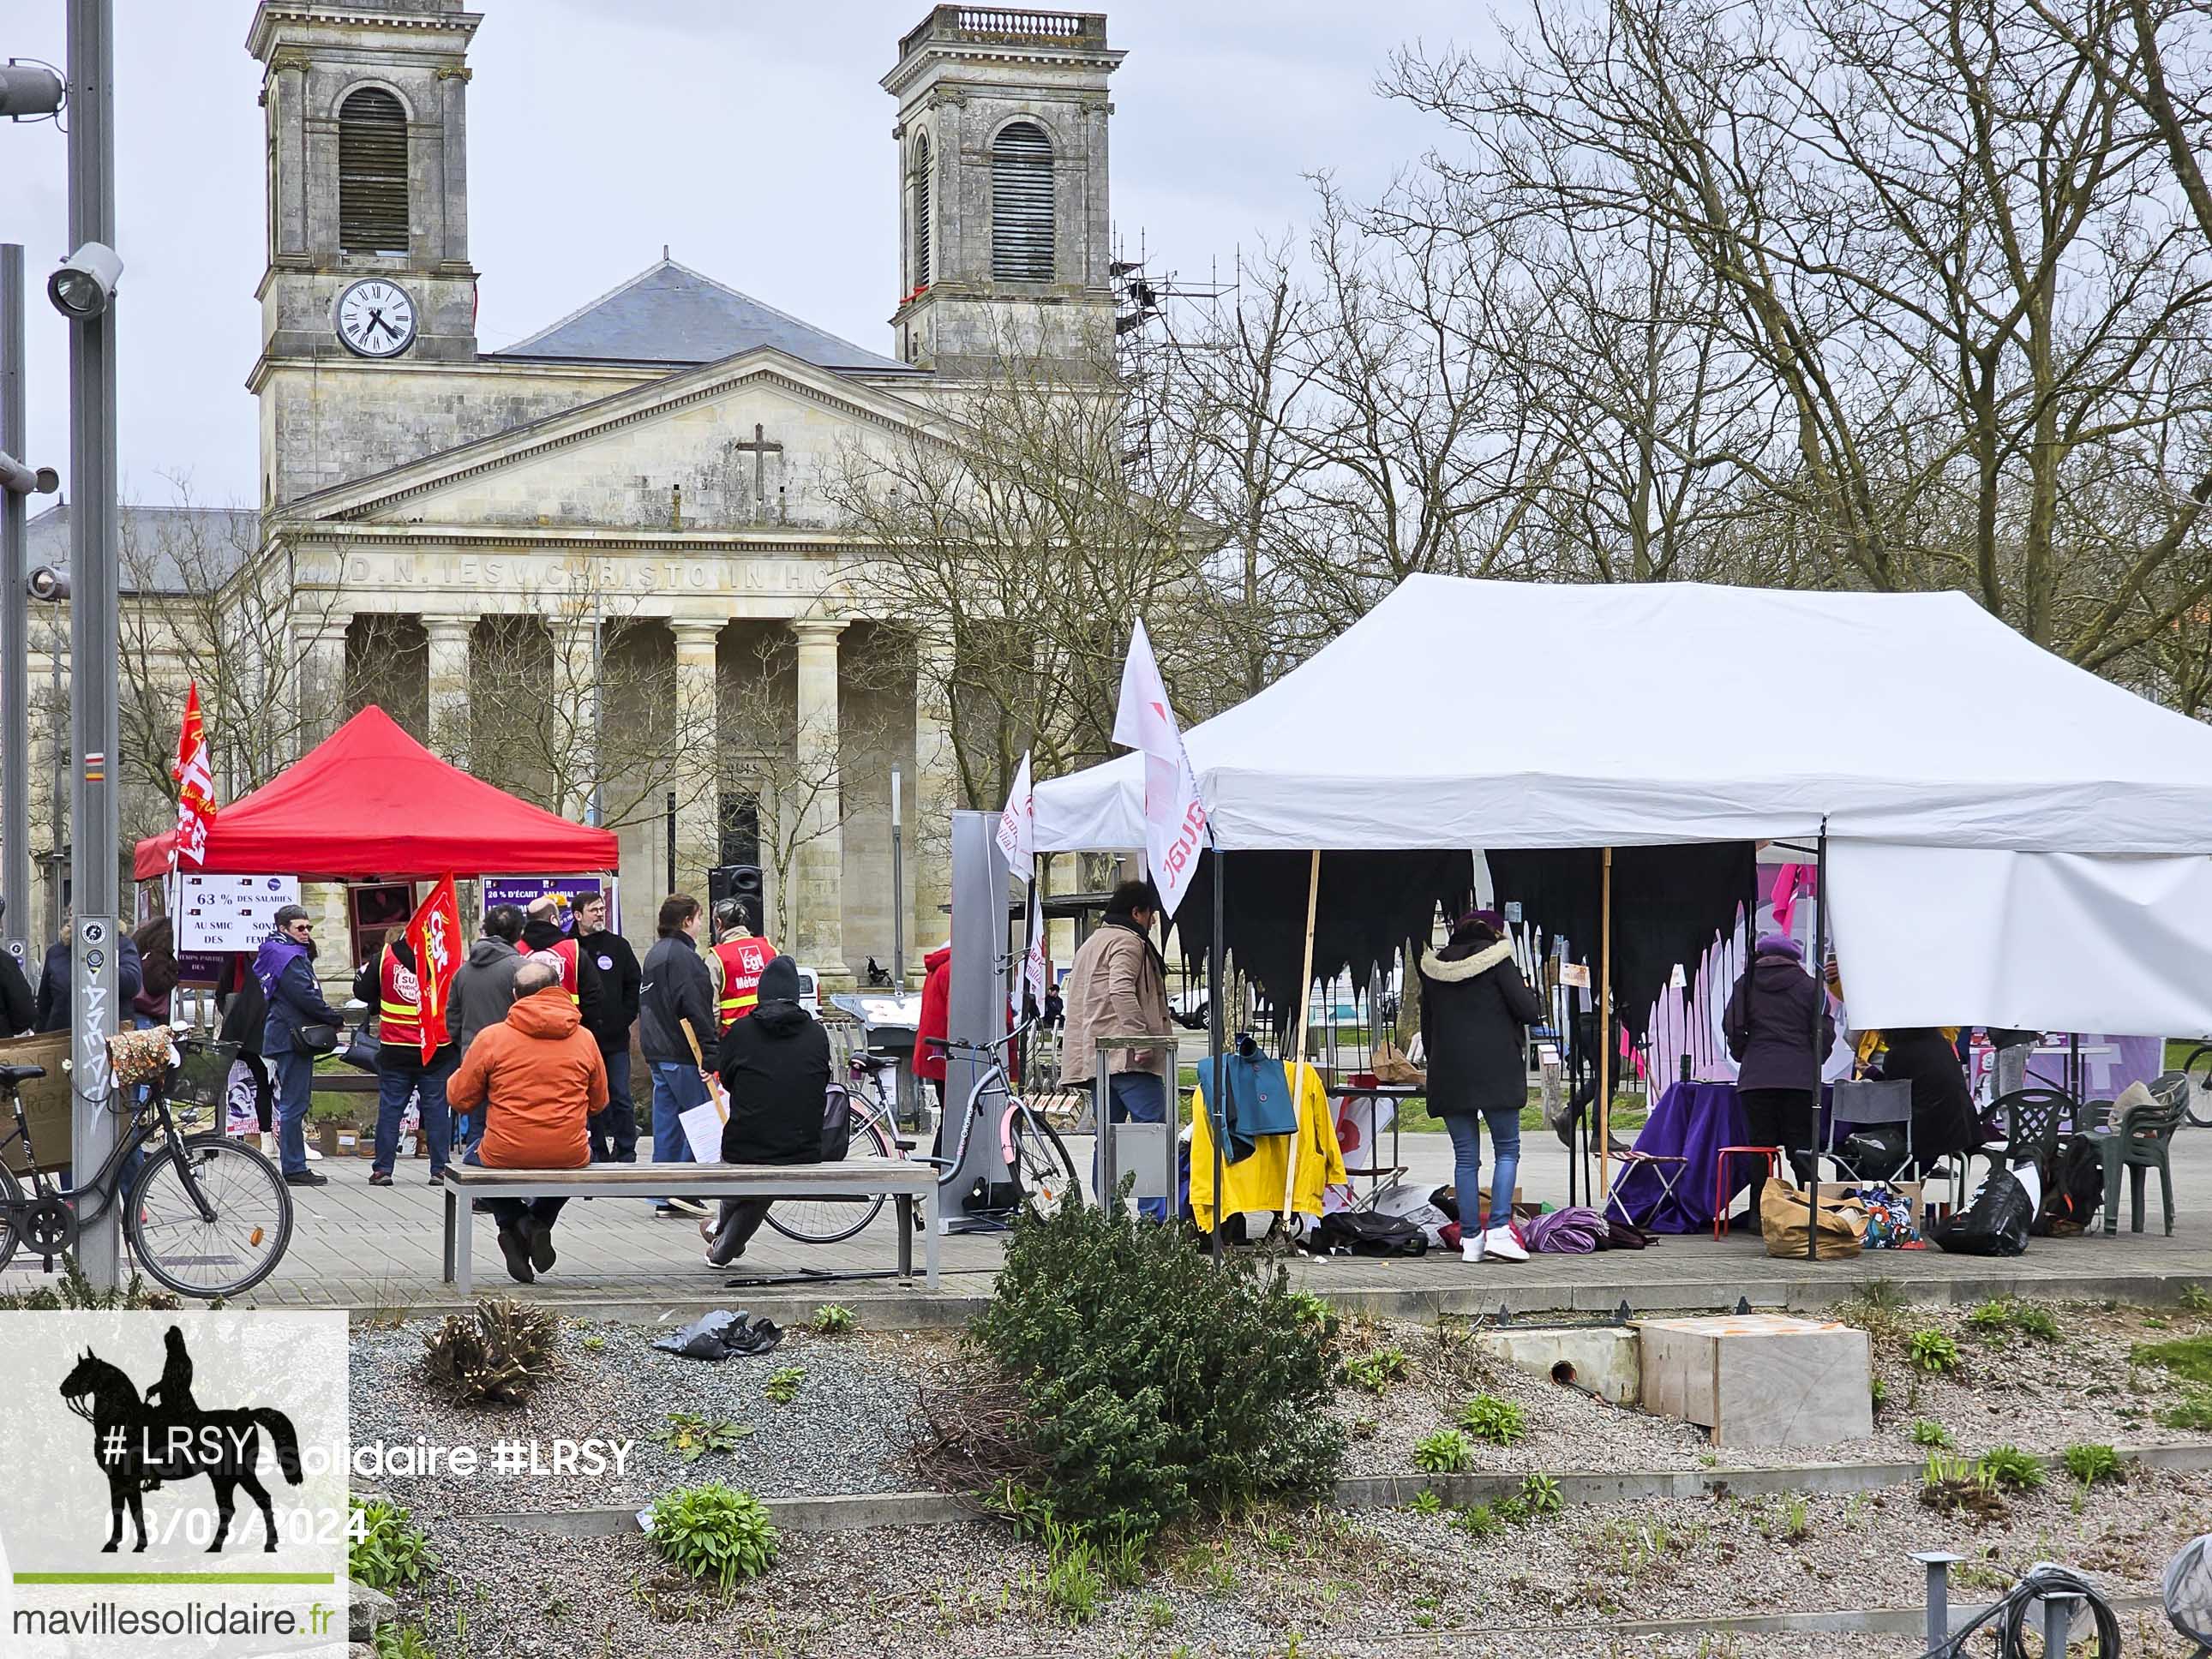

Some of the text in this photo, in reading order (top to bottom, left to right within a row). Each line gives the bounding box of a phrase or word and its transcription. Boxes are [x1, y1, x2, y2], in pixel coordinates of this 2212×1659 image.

[729, 563, 763, 590] IN
[197, 893, 215, 905] 63
[220, 893, 233, 905] %
[255, 893, 293, 902] SALARIÉS
[744, 953, 764, 970] cgt
